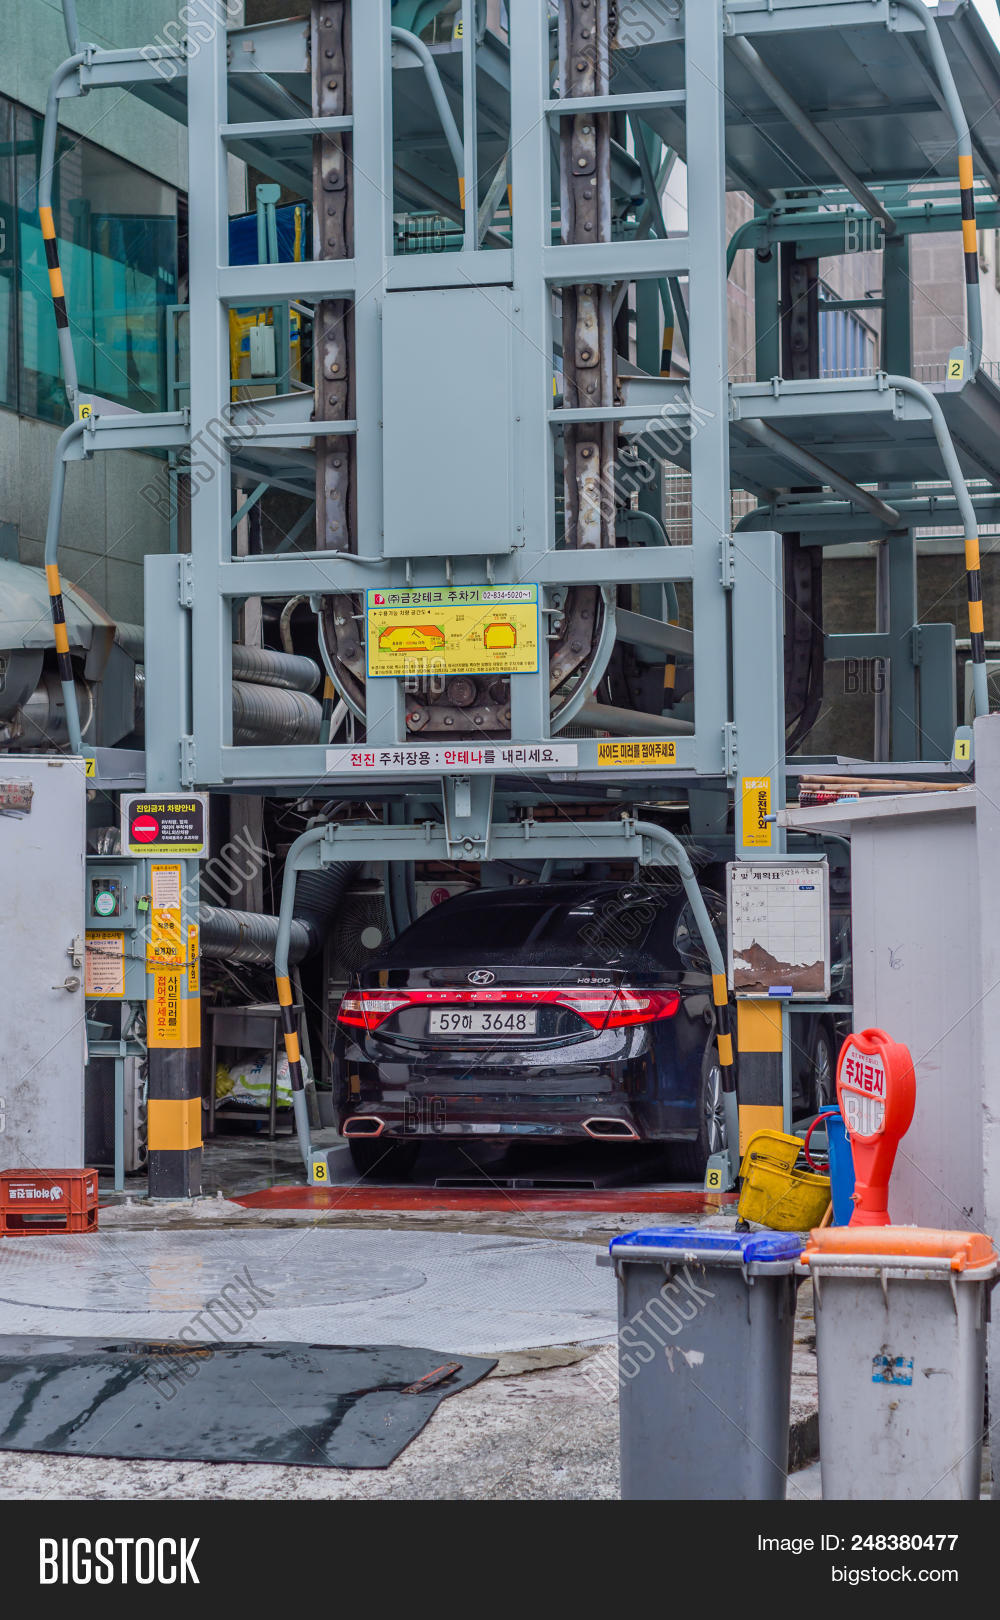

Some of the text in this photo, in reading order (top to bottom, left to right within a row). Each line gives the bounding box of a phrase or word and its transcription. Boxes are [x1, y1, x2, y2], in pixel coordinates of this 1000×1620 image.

[950, 362, 961, 377] 2
[81, 407, 90, 418] 6
[387, 592, 444, 605] (주)금강테크
[447, 590, 480, 602] 주차기
[350, 752, 375, 767] 전진
[379, 751, 431, 766] 주차장용
[444, 749, 496, 765] 안테나를
[502, 748, 559, 763] 내리세요.
[598, 743, 675, 759] 사이드 미러를 접어주세요
[960, 743, 967, 757] 1
[85, 761, 94, 774] 7
[136, 804, 196, 813] 진입금지 차량안내
[752, 871, 781, 880] 계획표
[157, 976, 167, 1026] 접어주세요
[439, 1012, 527, 1031] 59하 3648
[845, 1056, 884, 1096] 주차금지
[315, 1164, 325, 1179] 8
[709, 1172, 719, 1187] 8
